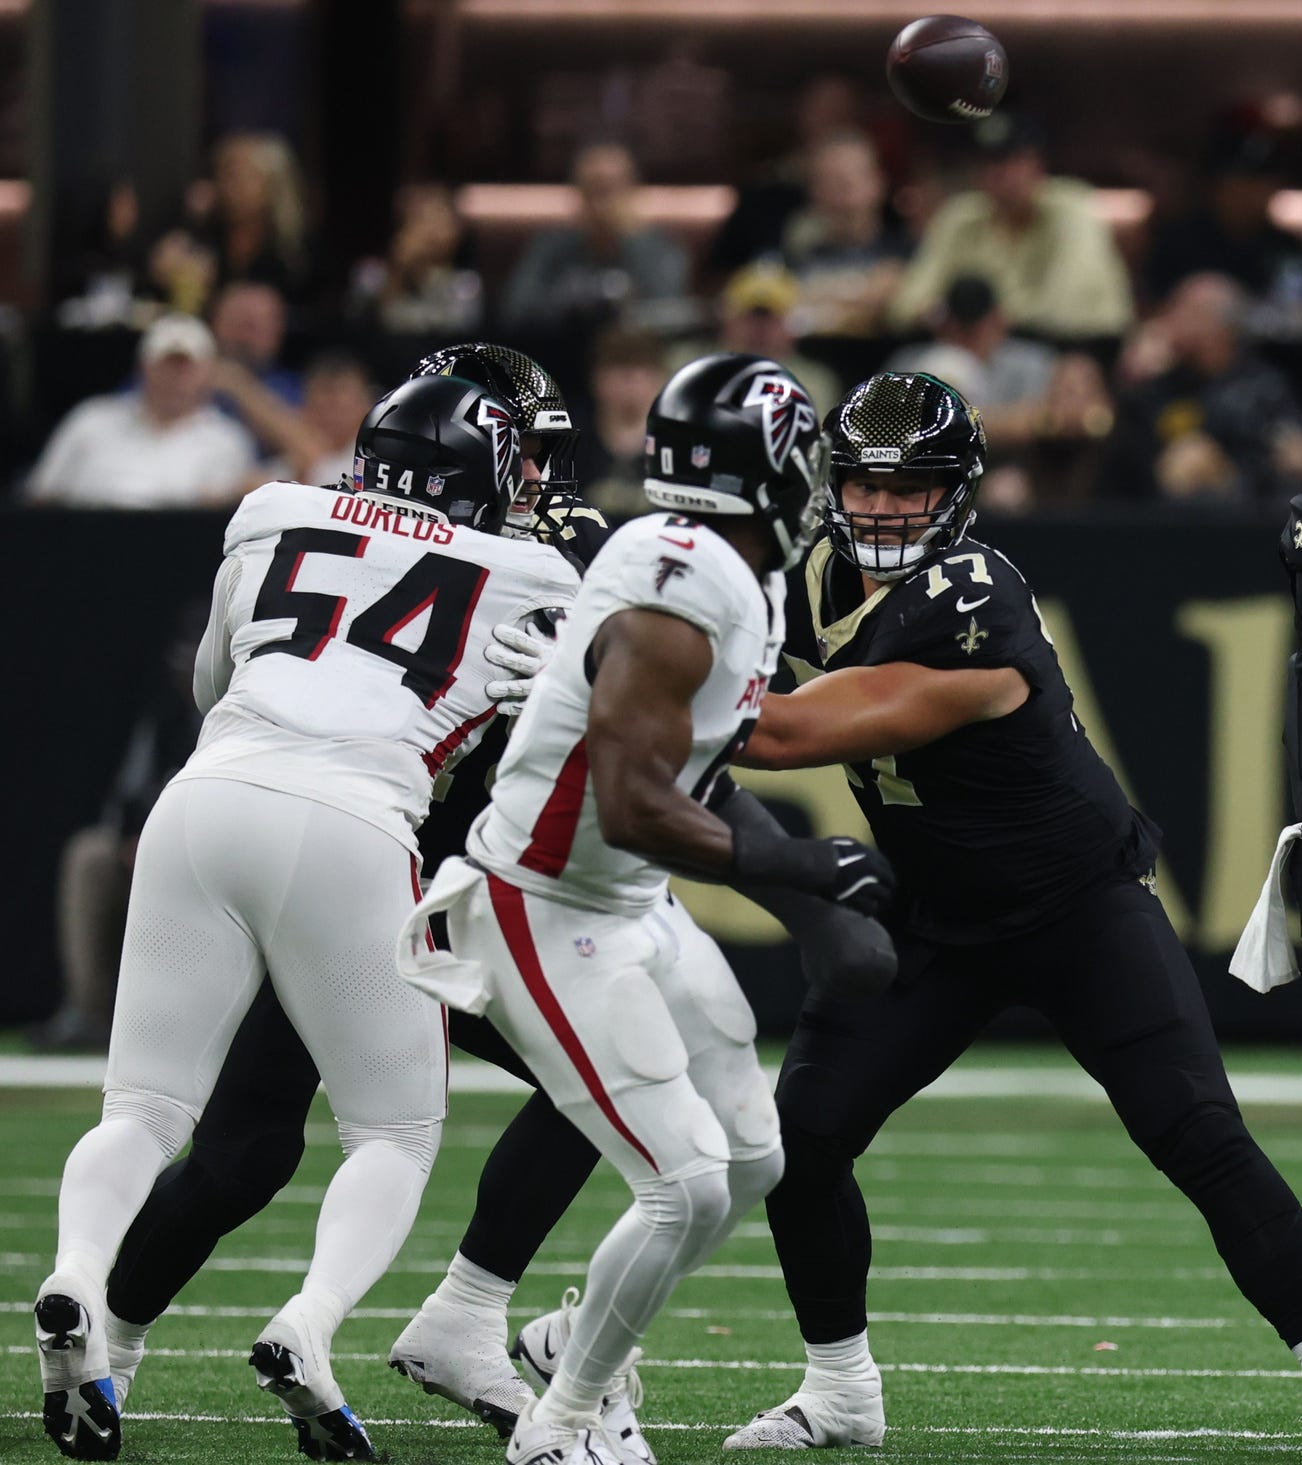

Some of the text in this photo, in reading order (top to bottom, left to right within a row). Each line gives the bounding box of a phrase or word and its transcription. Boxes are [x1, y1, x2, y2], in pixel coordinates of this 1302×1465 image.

[862, 449, 899, 460] SAINTS
[376, 463, 414, 495] 54
[245, 527, 491, 711] 54
